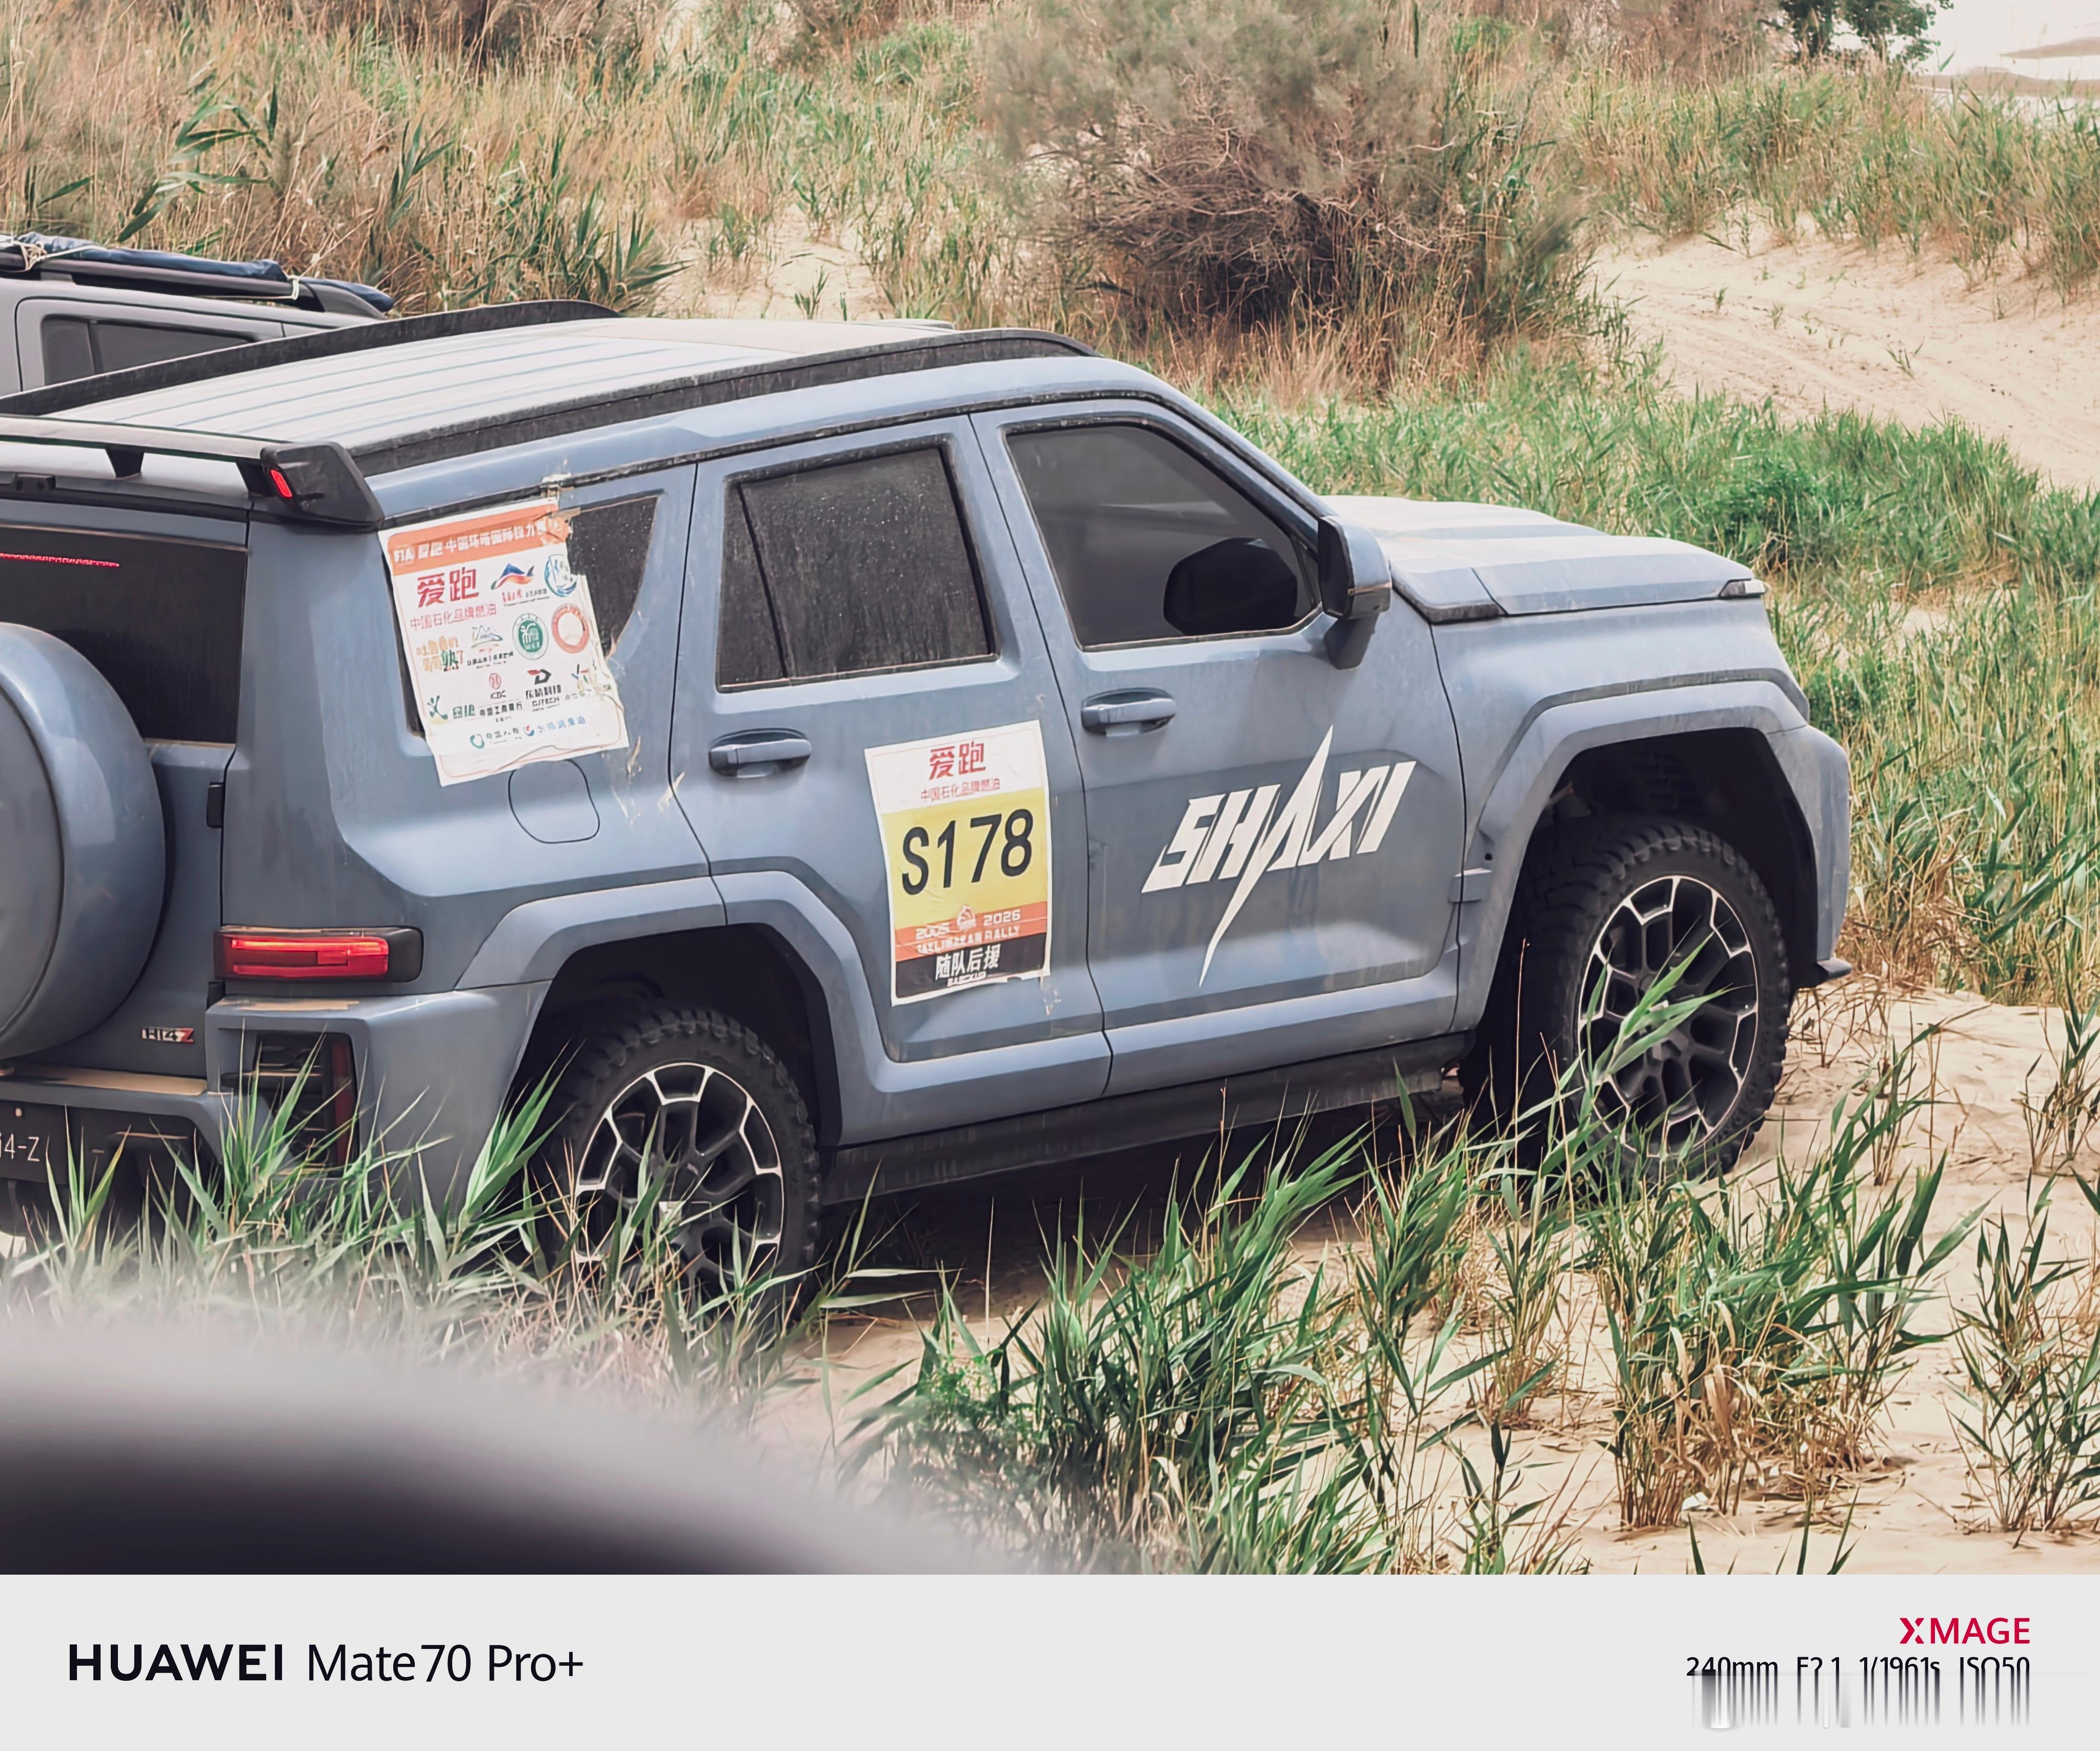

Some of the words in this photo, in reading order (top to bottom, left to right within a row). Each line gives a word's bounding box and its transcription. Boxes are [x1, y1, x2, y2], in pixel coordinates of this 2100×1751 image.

[416, 566, 479, 608] 爱跑
[929, 741, 986, 781] 爱跑
[902, 809, 1033, 895] S178
[984, 909, 1020, 926] 2026
[985, 926, 1020, 941] RALLY
[935, 944, 1001, 980] 随队后援
